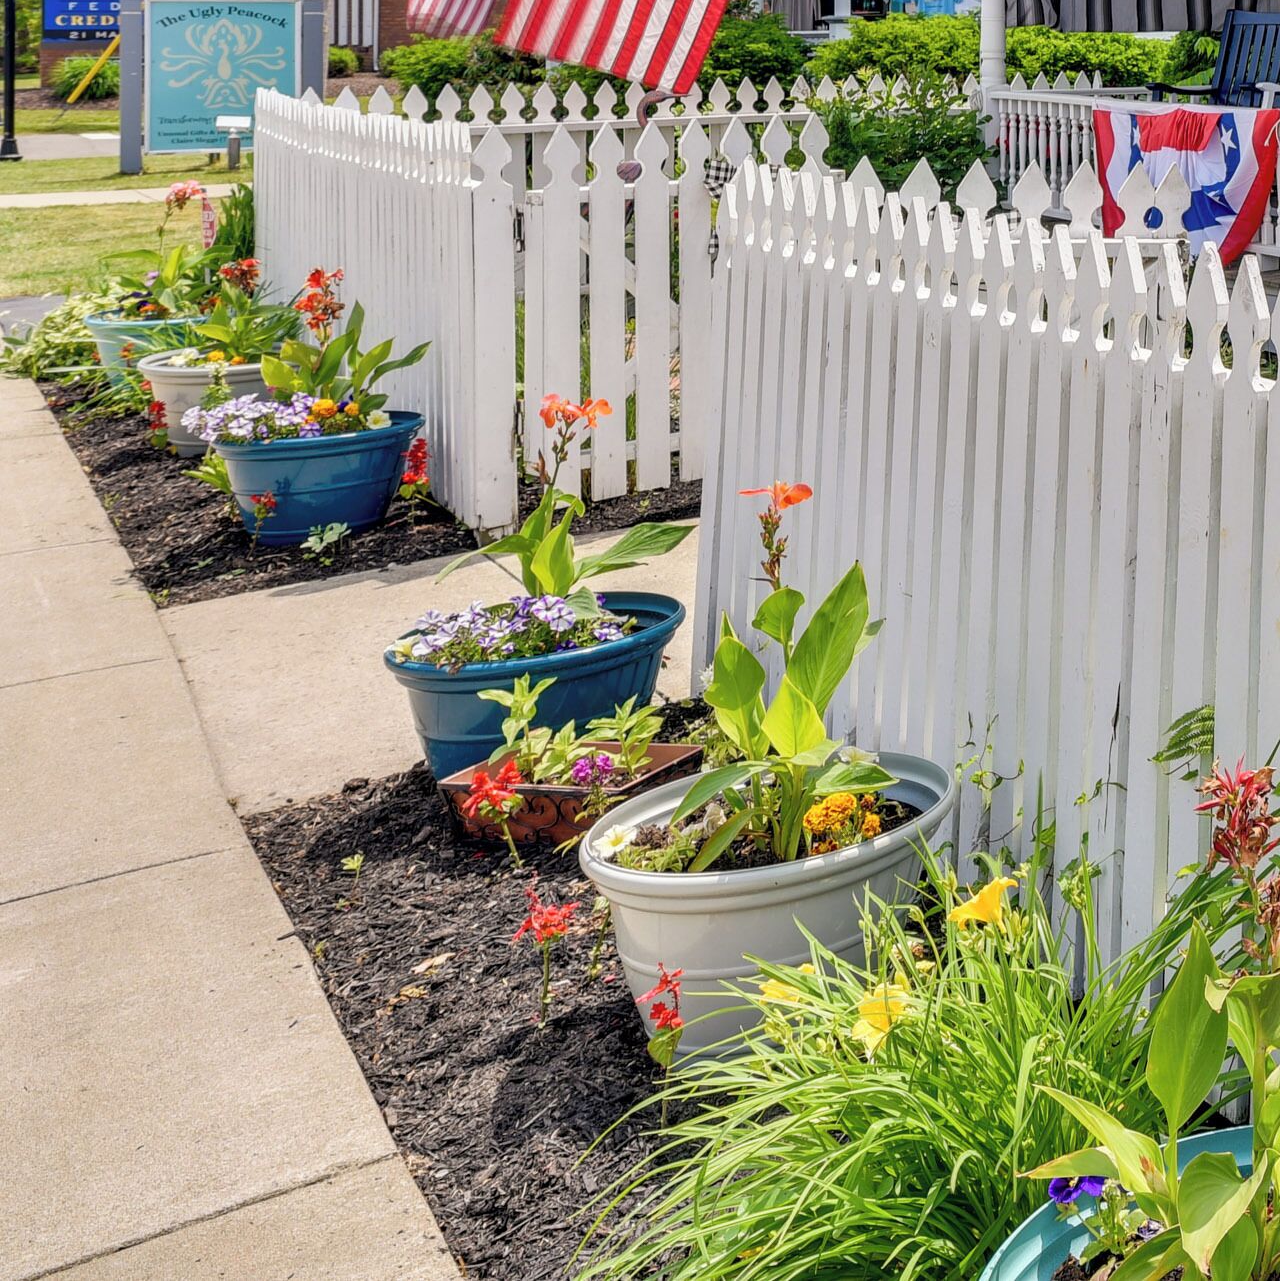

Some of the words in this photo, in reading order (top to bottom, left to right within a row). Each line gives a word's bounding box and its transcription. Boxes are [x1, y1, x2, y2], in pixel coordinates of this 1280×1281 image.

[68, 2, 121, 12] FED
[156, 14, 186, 28] The
[188, 6, 224, 19] Ugly
[227, 6, 289, 29] Peacock
[96, 31, 119, 39] MA
